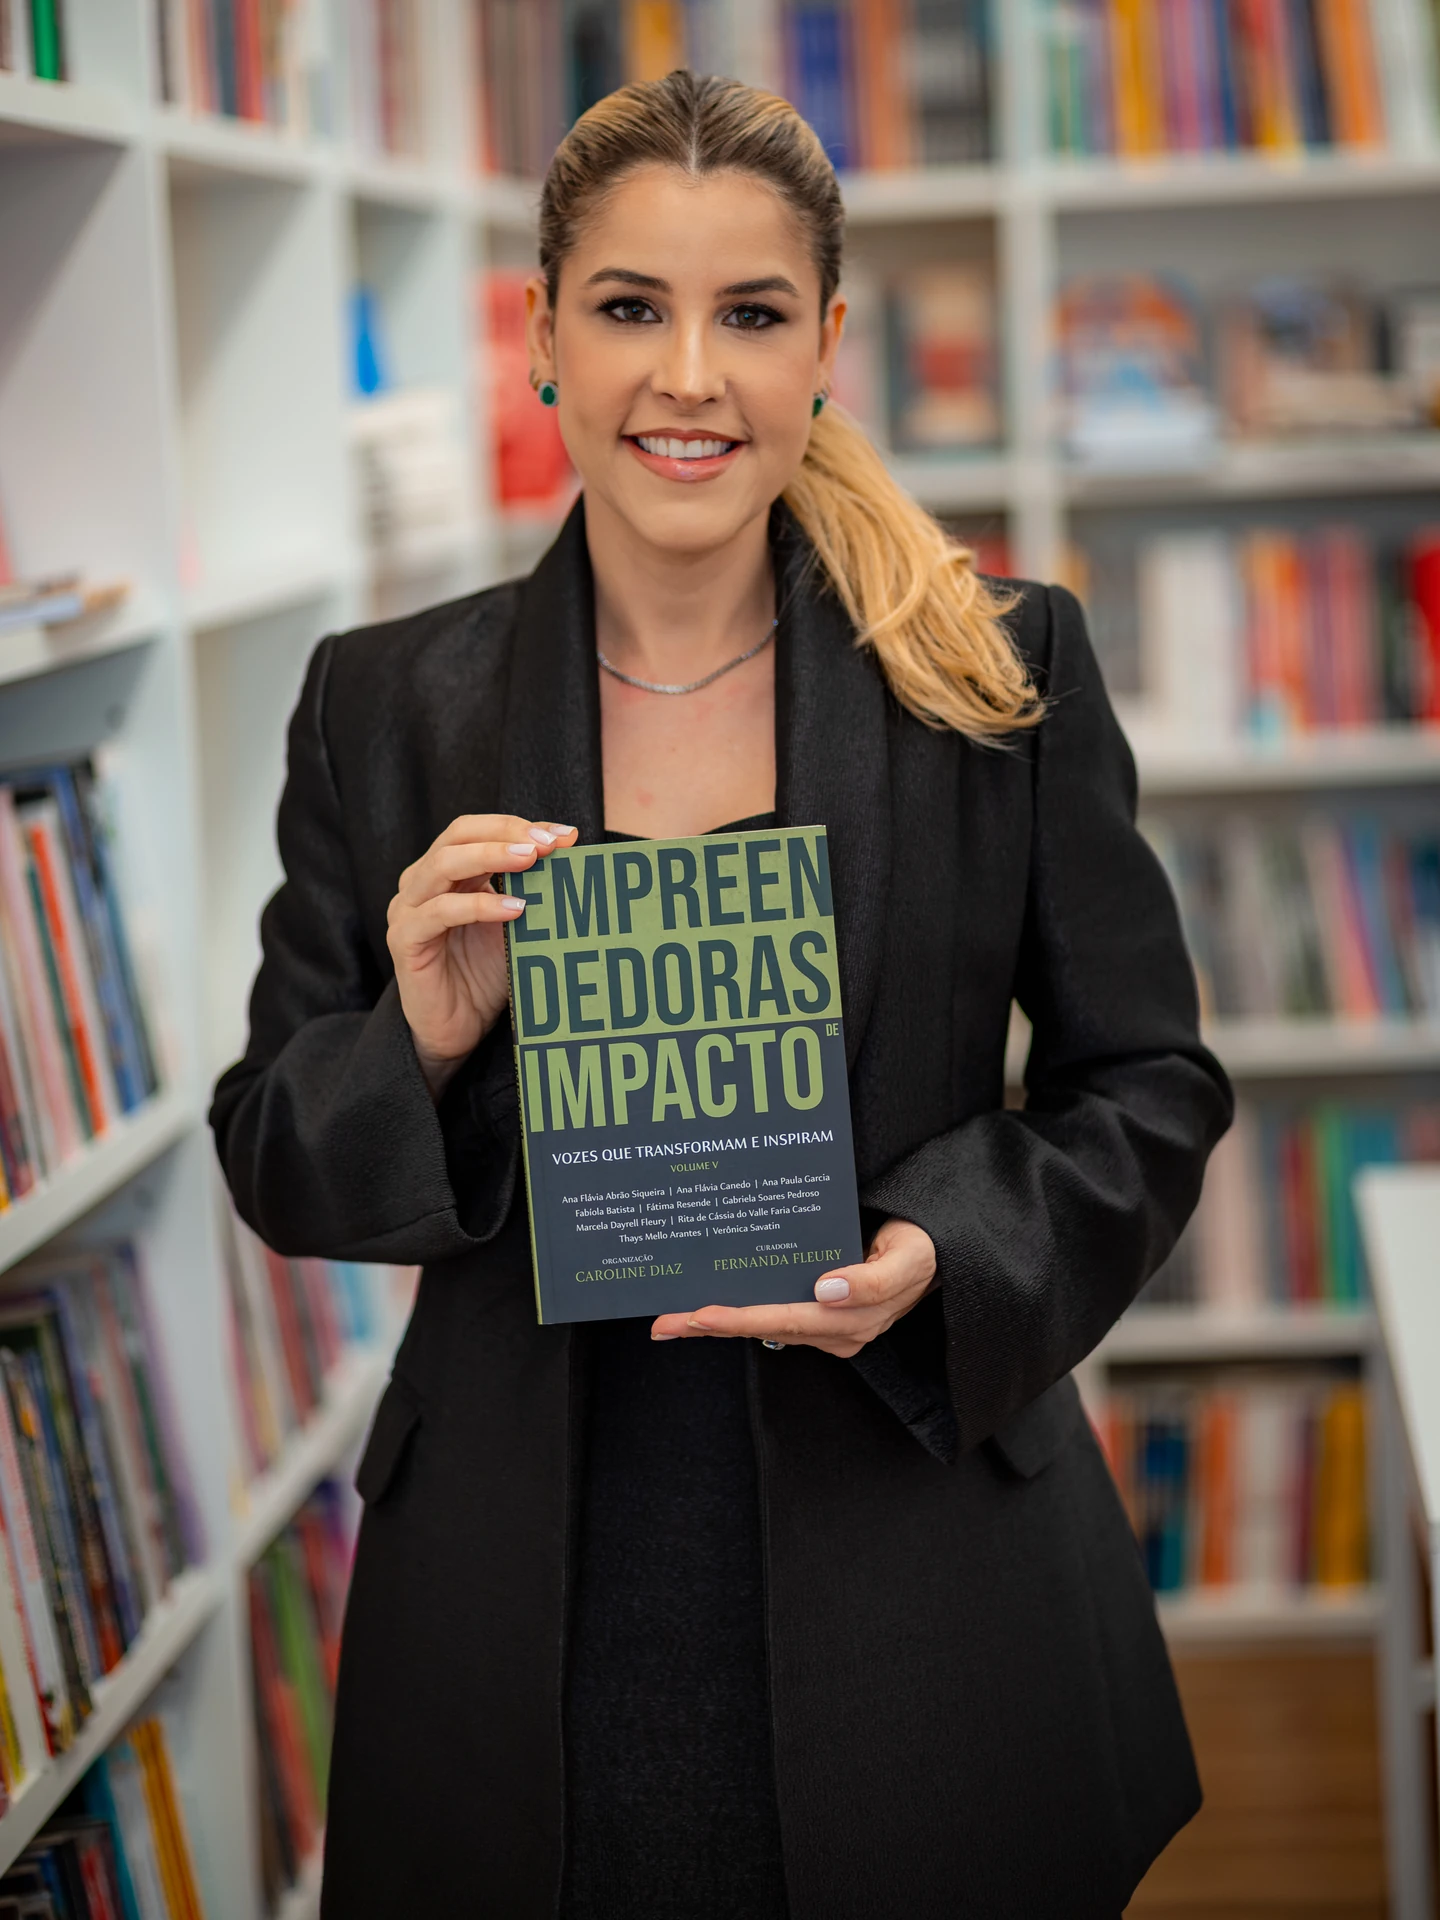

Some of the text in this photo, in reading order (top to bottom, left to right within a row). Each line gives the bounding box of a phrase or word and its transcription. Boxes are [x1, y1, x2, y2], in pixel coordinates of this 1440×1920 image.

[510, 835, 834, 943] EMPREEN
[517, 930, 831, 1037] DEDORAS
[826, 1023, 839, 1036] DE
[524, 1026, 824, 1132] IMPACTO
[552, 1130, 833, 1165] VOZES QUE TRANSFORMAM E INSPIRAM
[670, 1161, 719, 1173] VOLUME V
[562, 1174, 830, 1204] Ana Flávia Abrão Siqueira Ana Flávia Canedo Ana Paula Garcia
[606, 1205, 635, 1215] Batista
[646, 1202, 674, 1212] Fátima
[676, 1198, 711, 1209] Resende
[722, 1194, 756, 1205] Gabriela
[758, 1192, 785, 1202] Soares
[787, 1190, 819, 1200] Pedroso
[576, 1204, 821, 1232] Marcela Dayrell Fleury Rita de Cássia do Valle Faria Cascão
[619, 1222, 780, 1244] Thays Mello Arantes Verônica Savatin
[755, 1242, 798, 1252] CURADORIA
[602, 1254, 653, 1265] ORGANIZAÇÃO
[714, 1248, 842, 1271] FERNANDA FLEURY
[575, 1262, 683, 1282] CAROLINE DIAZ
